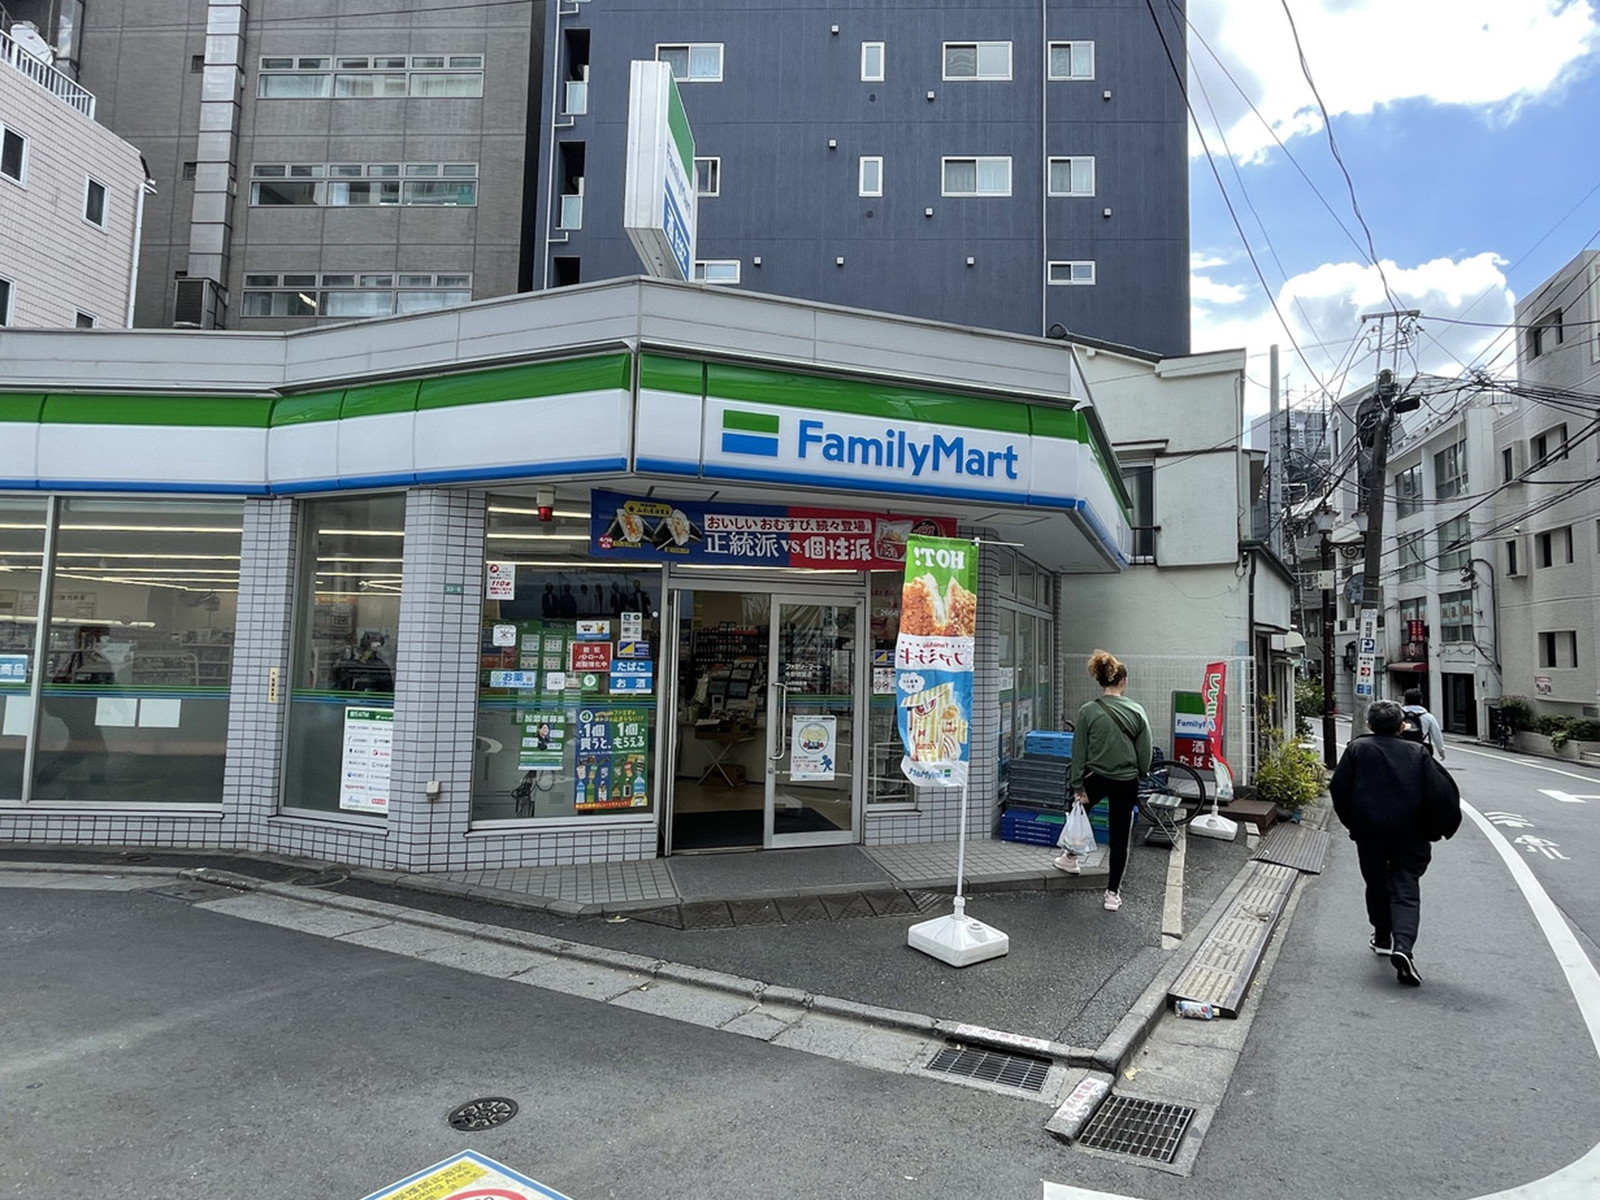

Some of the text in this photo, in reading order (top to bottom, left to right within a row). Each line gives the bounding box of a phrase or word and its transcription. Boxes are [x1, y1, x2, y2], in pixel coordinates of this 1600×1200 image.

[799, 419, 1019, 480] FamilyMart
[617, 661, 646, 671] たばこ
[616, 678, 646, 688] お酒
[617, 723, 638, 737] 1個
[1177, 718, 1206, 729] Family
[584, 724, 605, 737] 1個
[613, 736, 645, 749] もらえる
[1192, 740, 1205, 753] 酒
